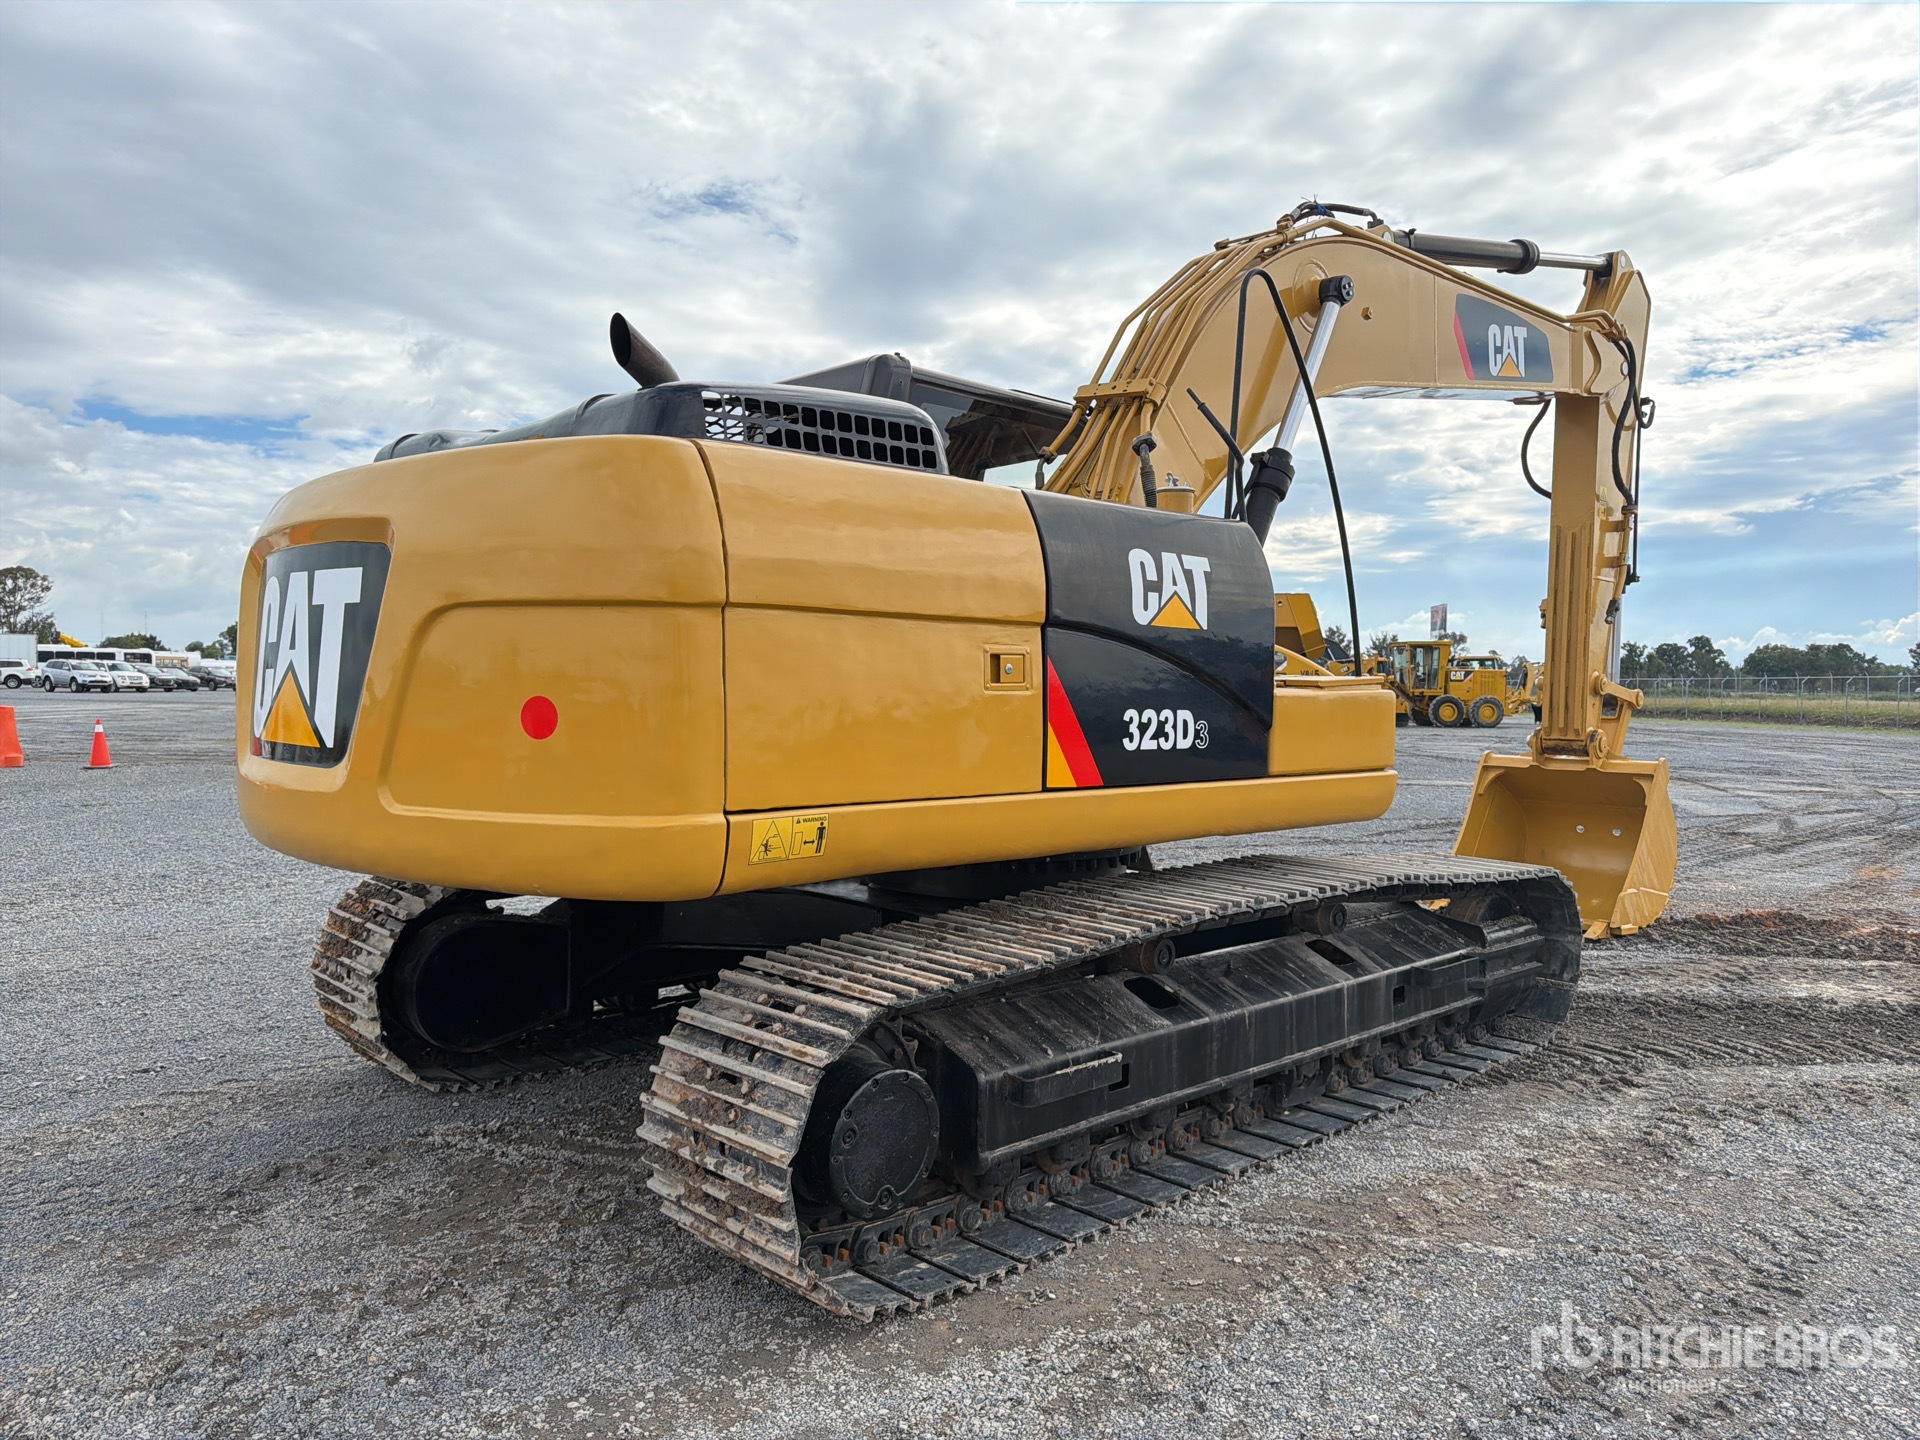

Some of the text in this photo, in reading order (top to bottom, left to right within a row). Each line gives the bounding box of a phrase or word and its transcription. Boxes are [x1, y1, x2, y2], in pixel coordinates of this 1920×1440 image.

[1488, 324, 1527, 377] CAT
[1128, 548, 1211, 630] CAT
[254, 567, 363, 748] CAT
[1451, 671, 1465, 680] CAT
